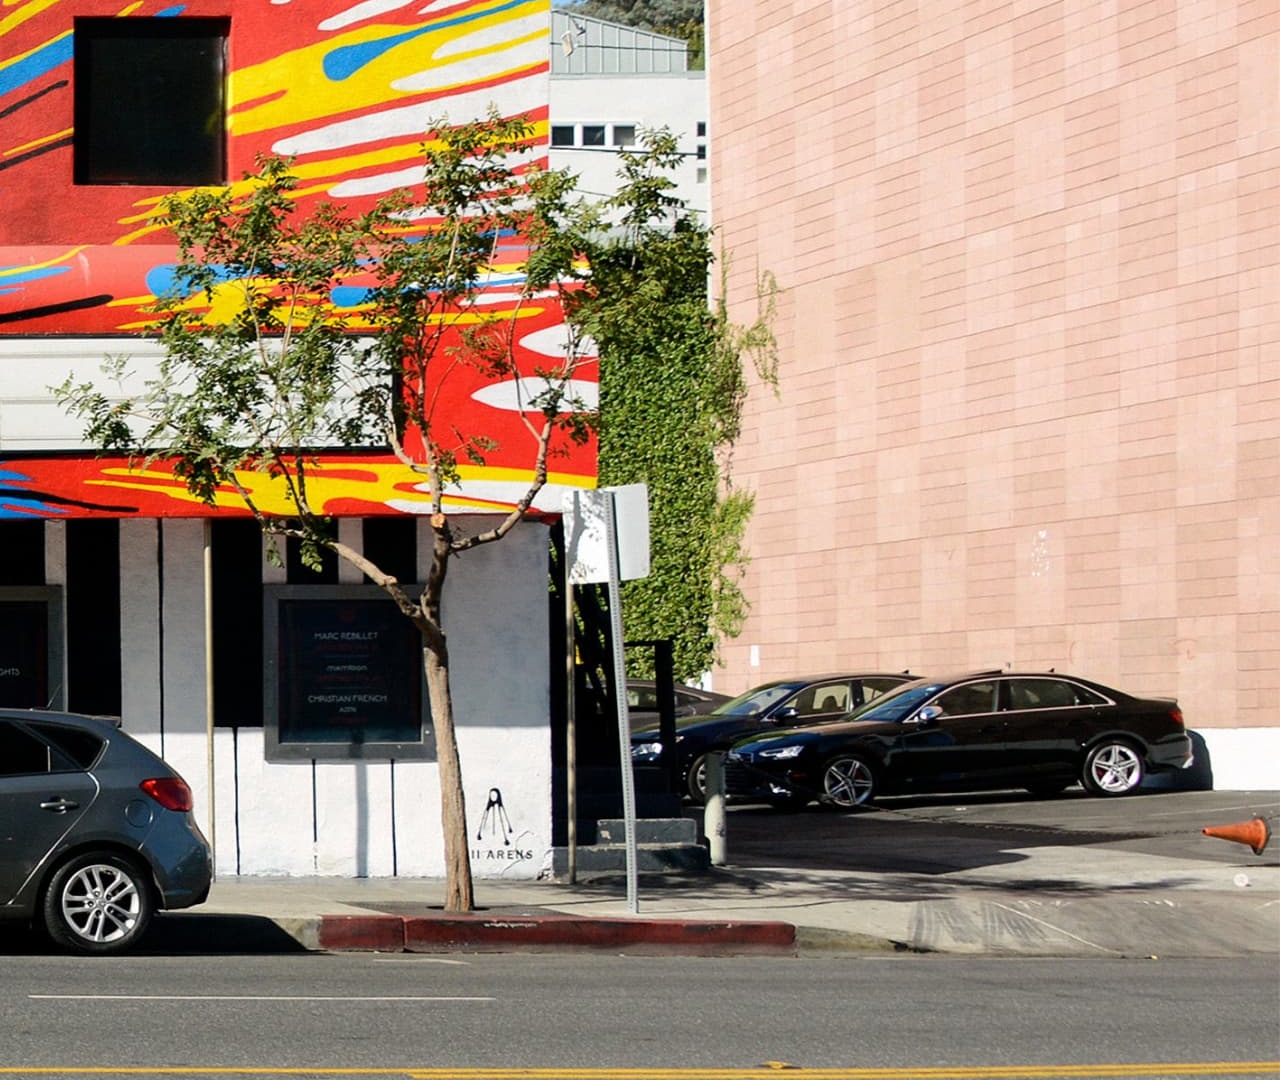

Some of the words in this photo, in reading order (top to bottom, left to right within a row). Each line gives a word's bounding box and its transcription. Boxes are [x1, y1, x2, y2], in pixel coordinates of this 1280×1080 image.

[314, 631, 339, 641] MARC
[307, 694, 352, 704] CHRISTIAN
[352, 694, 388, 704] FRENCH
[486, 849, 534, 860] ARENS
